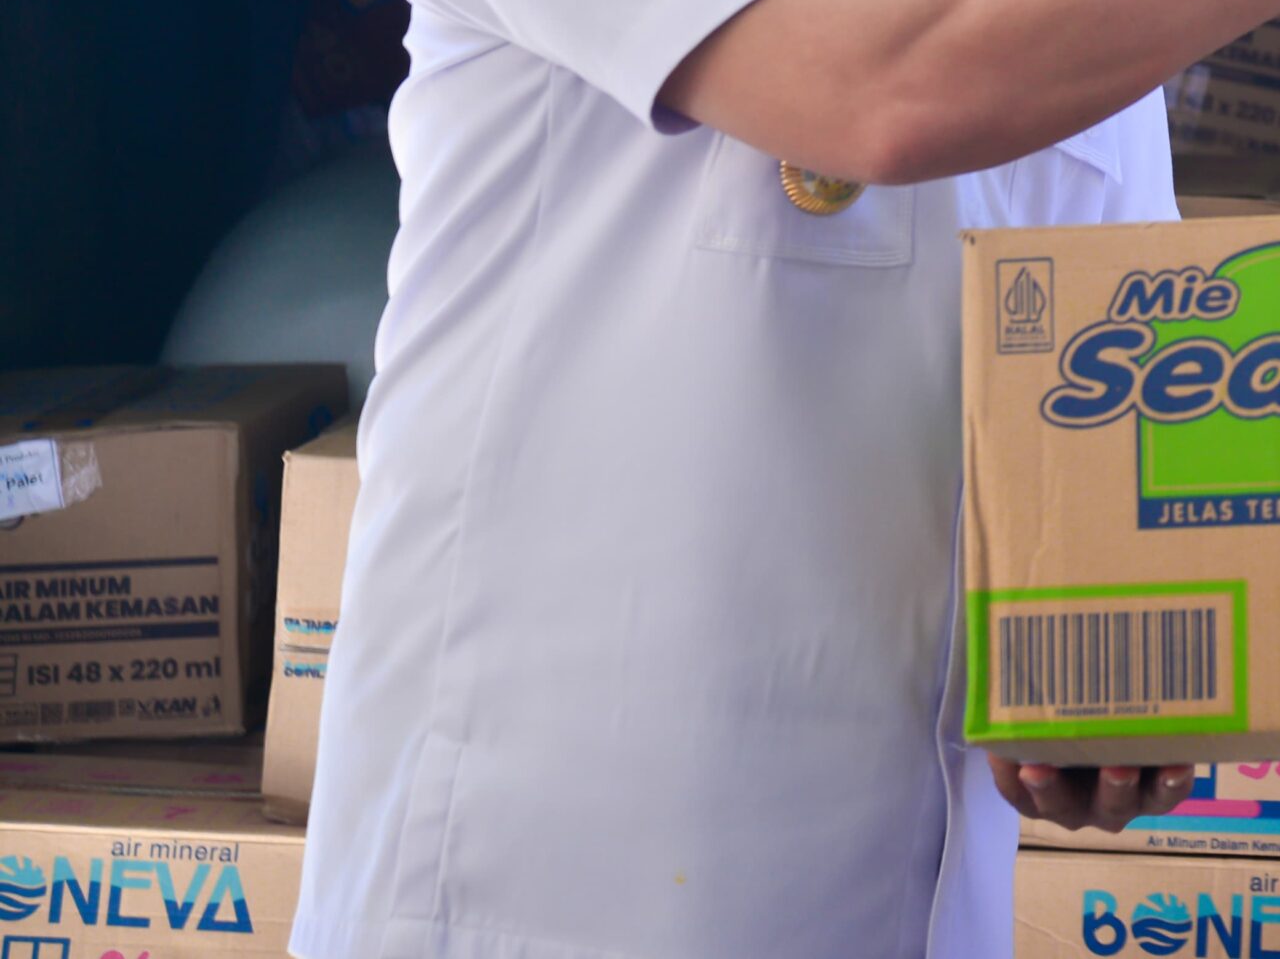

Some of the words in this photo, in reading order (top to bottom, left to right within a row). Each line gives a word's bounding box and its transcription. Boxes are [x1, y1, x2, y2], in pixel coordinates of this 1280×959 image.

[1108, 267, 1241, 323] Mie
[1158, 495, 1233, 523] JELAS
[36, 576, 131, 598] MINUM
[0, 603, 80, 623] ALAM
[86, 596, 219, 619] KEMASAN
[27, 665, 60, 686] ISI
[67, 661, 101, 684] 48
[109, 663, 124, 681] x
[132, 657, 178, 681] 220
[186, 652, 221, 678] ml
[154, 697, 196, 714] KAN
[111, 839, 141, 858] air
[150, 840, 239, 863] mineral
[1147, 835, 1163, 848] Air
[1167, 836, 1207, 850] Minum
[1210, 838, 1249, 851] Dalam
[1249, 874, 1279, 892] air
